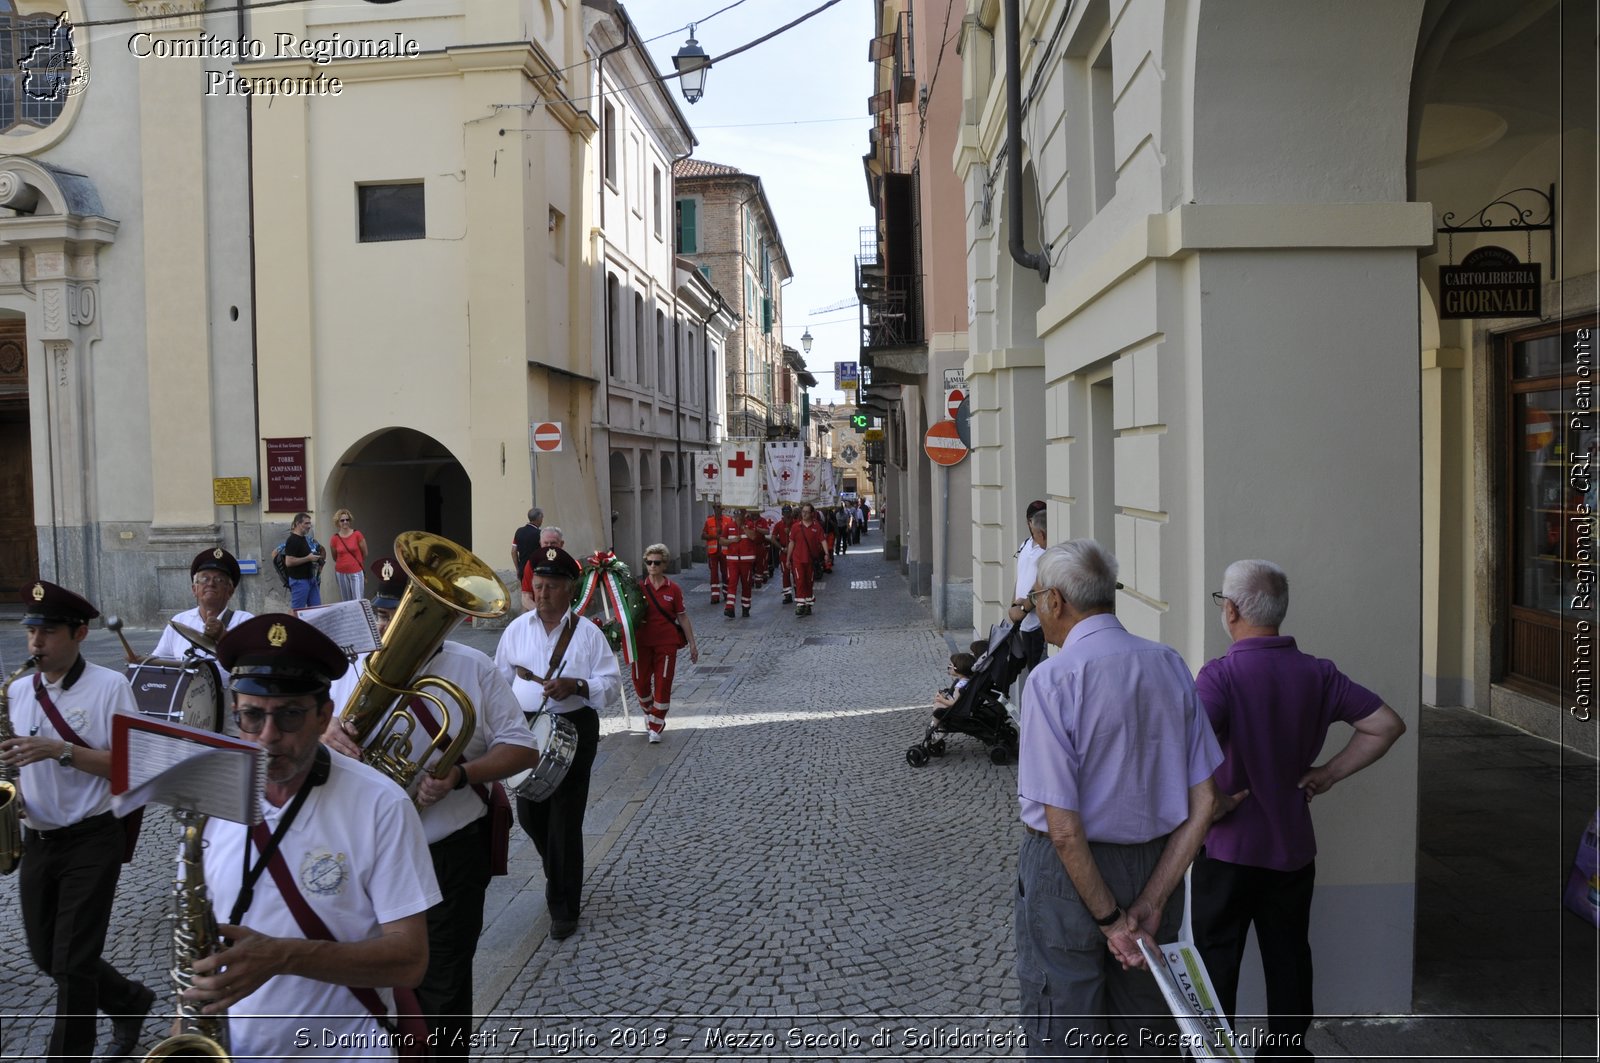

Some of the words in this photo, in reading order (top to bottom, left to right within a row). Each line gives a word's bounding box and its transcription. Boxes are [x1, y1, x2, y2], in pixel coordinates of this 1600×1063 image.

[1445, 271, 1535, 286] CARTOLIBRERIA
[1446, 288, 1534, 313] GIORNALI
[270, 465, 303, 473] CAMPANARIA
[1178, 972, 1192, 992] LA
